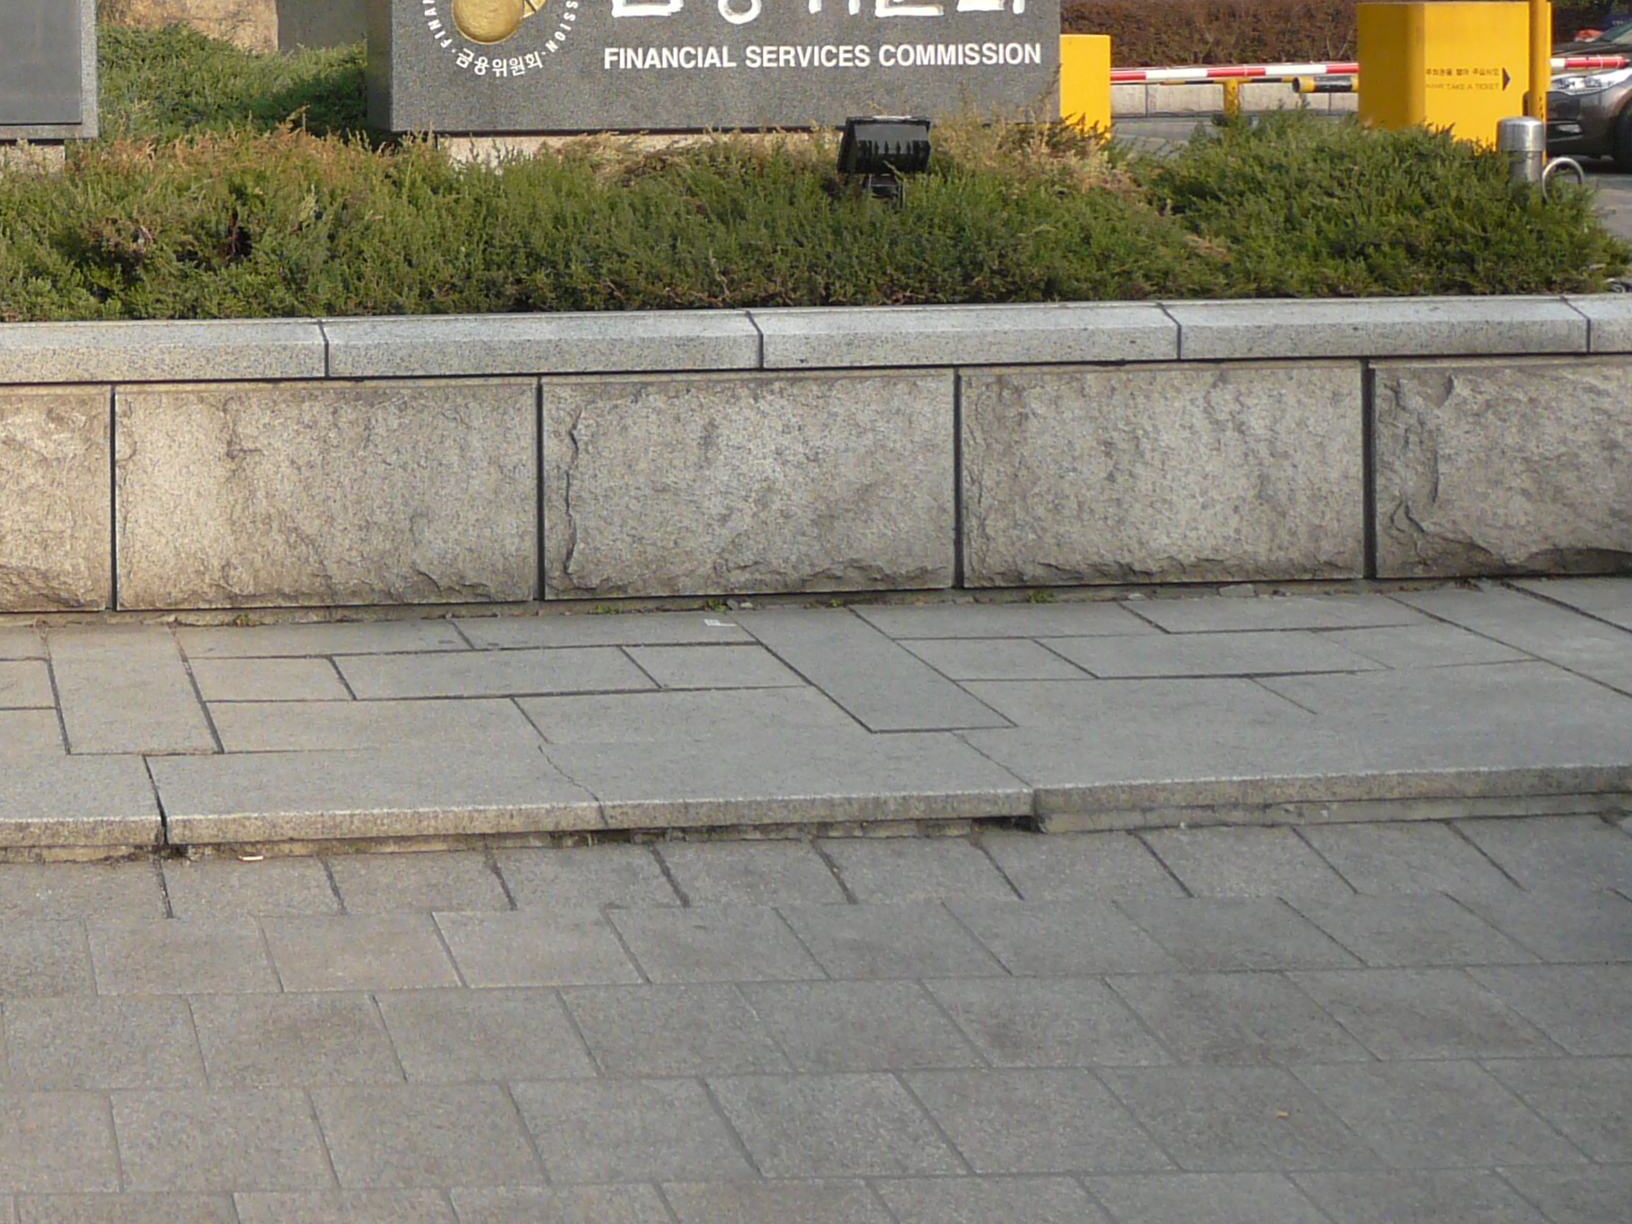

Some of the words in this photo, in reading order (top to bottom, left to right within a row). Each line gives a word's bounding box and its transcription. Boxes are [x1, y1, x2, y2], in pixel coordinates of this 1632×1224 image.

[455, 47, 545, 77] 금융위원회
[604, 47, 738, 70] FINANCIAL
[745, 46, 872, 69] SERVICES
[879, 43, 1042, 68] COMMISSION
[1446, 83, 1465, 91] TAKE
[1475, 83, 1500, 91] TICKET
